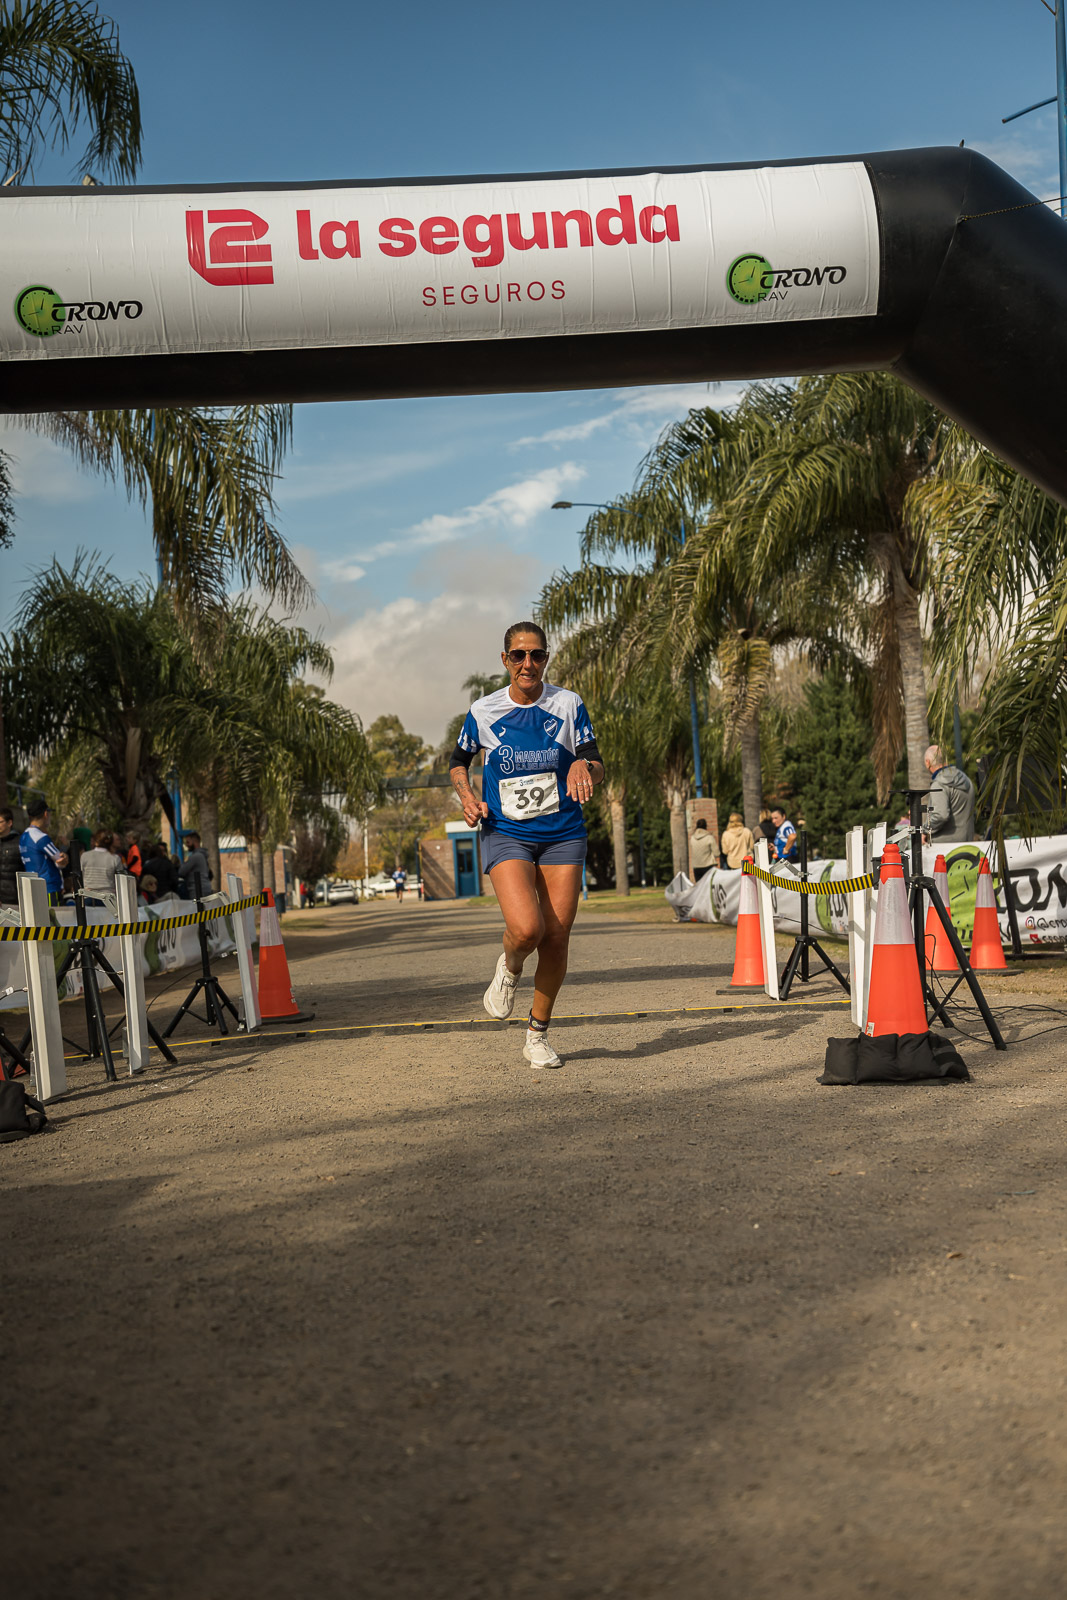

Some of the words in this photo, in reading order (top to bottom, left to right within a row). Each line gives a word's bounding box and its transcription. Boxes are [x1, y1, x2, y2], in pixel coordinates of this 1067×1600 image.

[296, 209, 361, 260] la
[378, 195, 681, 268] segunda
[422, 279, 566, 307] SEGUROS
[757, 290, 789, 302] RAV
[52, 324, 84, 335] RAV
[498, 745, 515, 775] 3
[514, 786, 545, 810] 39
